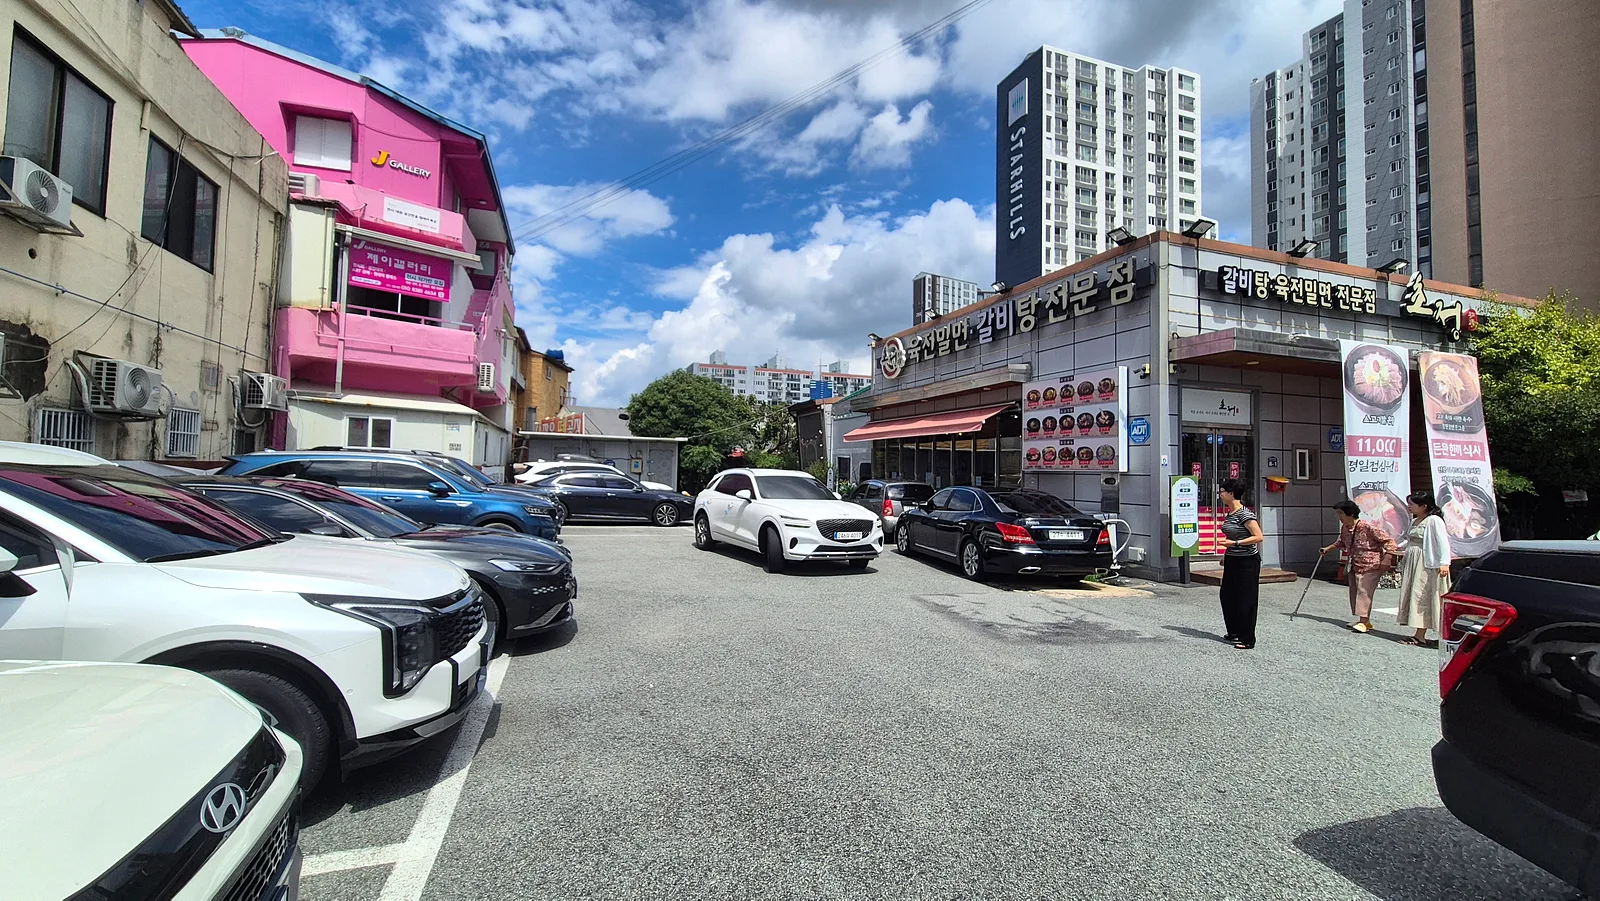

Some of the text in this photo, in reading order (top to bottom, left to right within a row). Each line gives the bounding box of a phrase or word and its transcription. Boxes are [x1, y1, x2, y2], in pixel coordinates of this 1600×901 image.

[371, 149, 431, 178] J GALLERY
[1009, 126, 1026, 240] STARHILLS
[364, 246, 387, 254] GALLERY
[366, 252, 431, 276] 제이갤러리
[1337, 286, 1377, 315] 전문점
[1131, 426, 1147, 436] ADT
[1463, 444, 1482, 458] 식사
